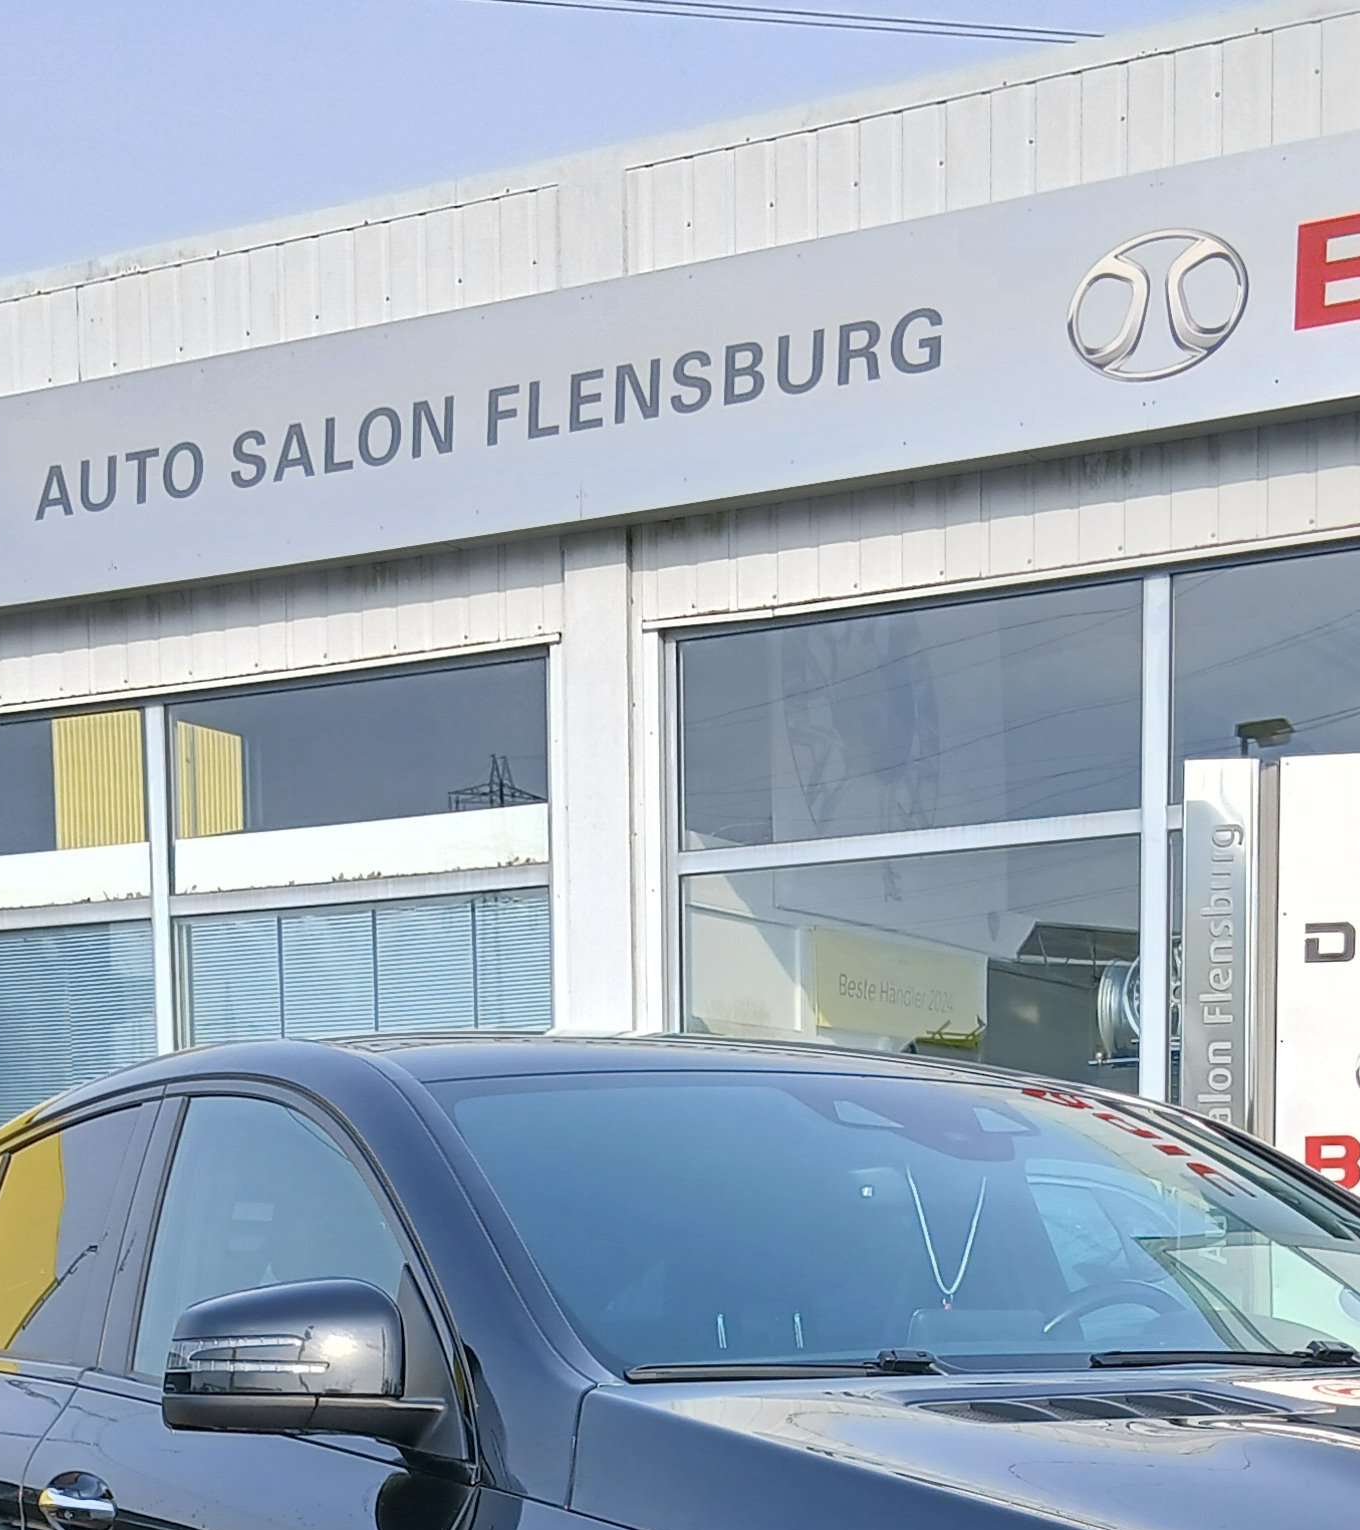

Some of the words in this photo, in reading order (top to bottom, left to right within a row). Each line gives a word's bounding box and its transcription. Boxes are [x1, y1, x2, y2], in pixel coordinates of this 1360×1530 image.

[35, 441, 204, 522] AUTO
[230, 395, 455, 489] SALON
[486, 307, 944, 446] FLENSBURG
[838, 973, 877, 1001] Beste
[1200, 824, 1244, 1027] Flensburg
[1197, 1041, 1232, 1124] alon
